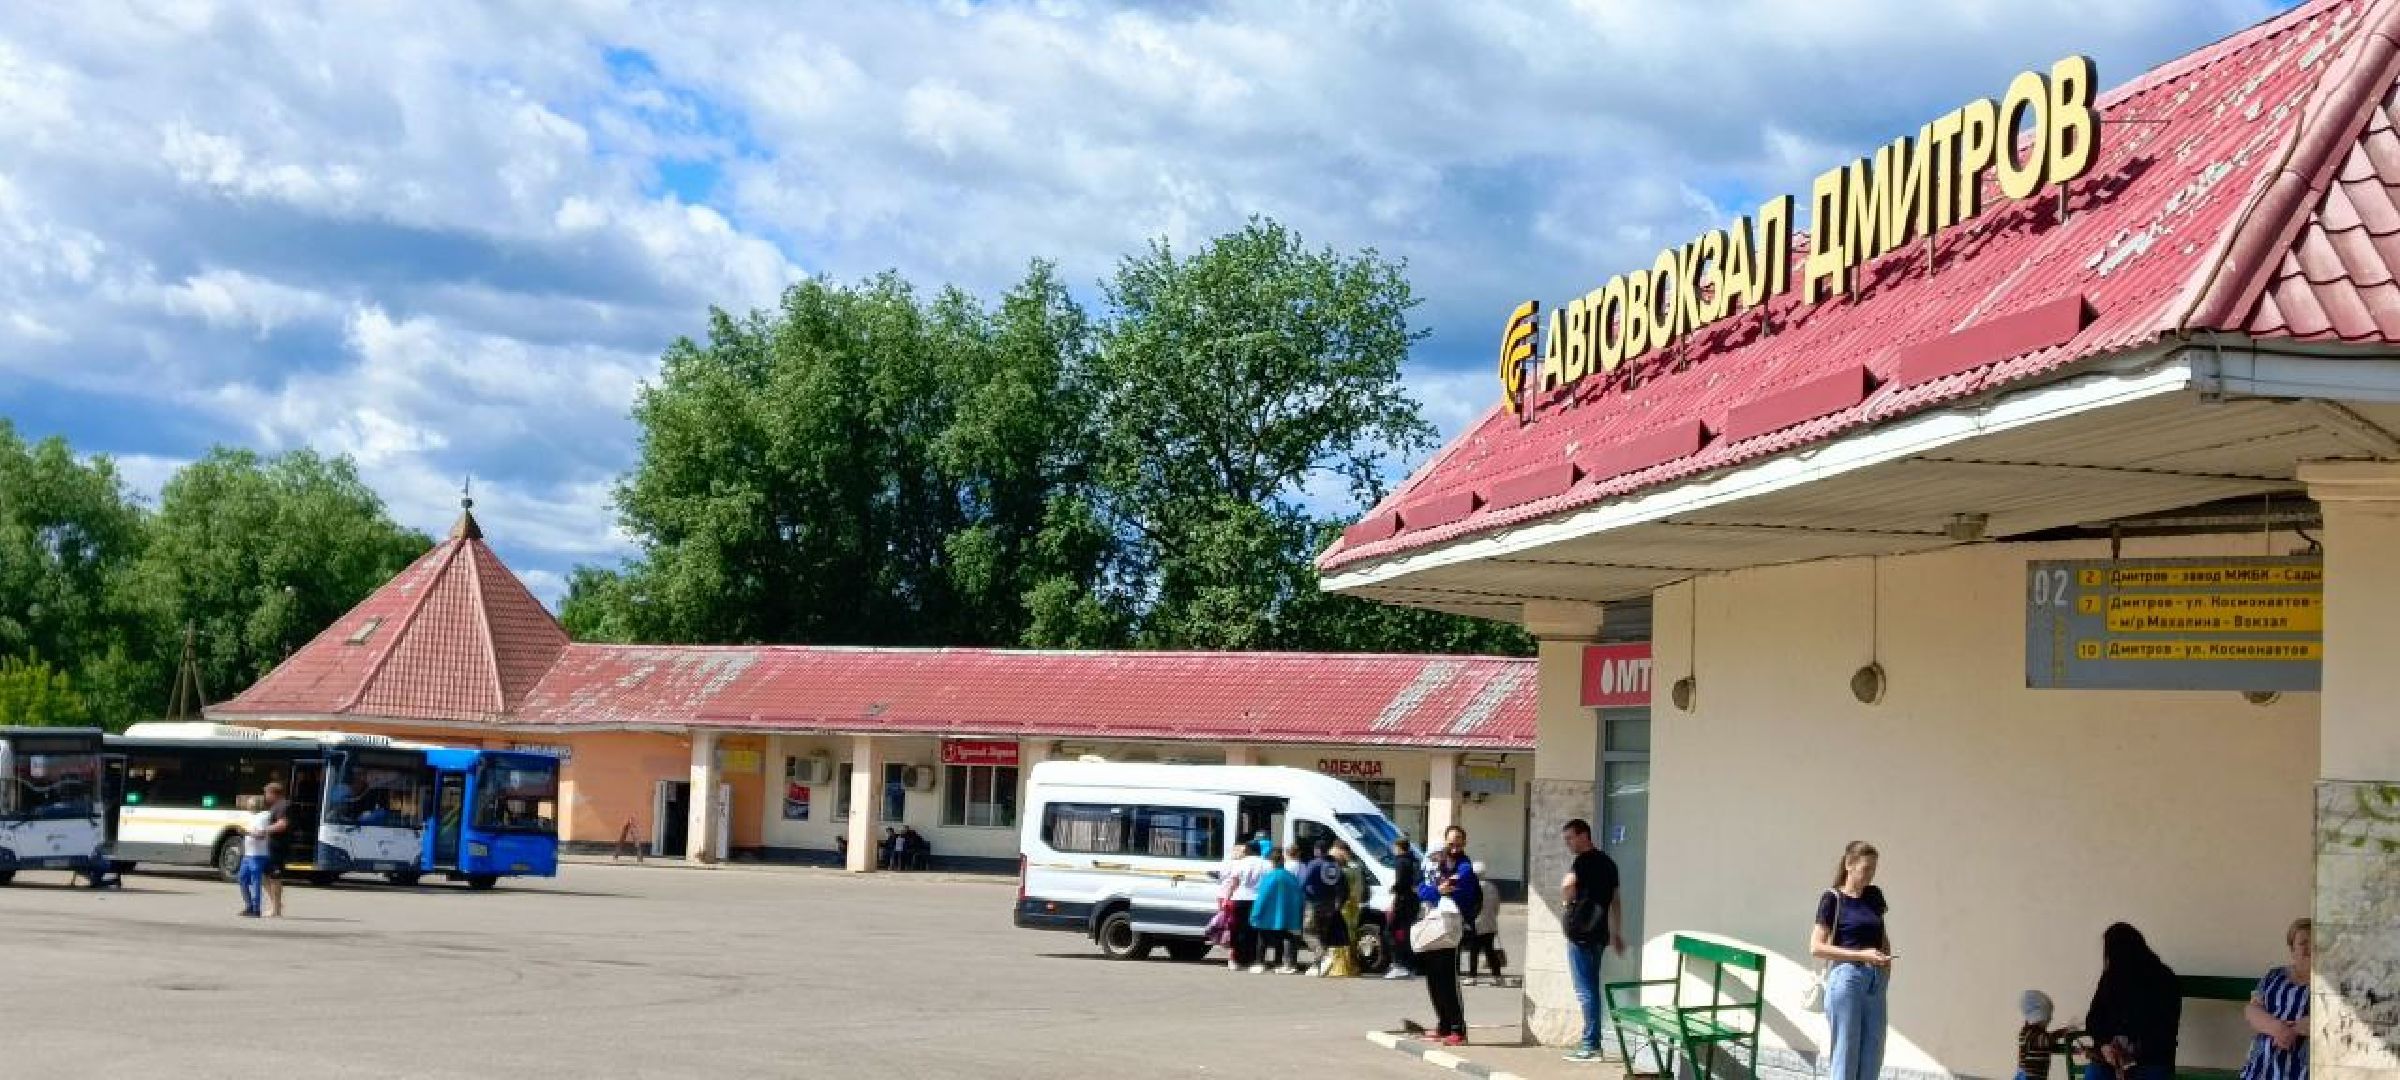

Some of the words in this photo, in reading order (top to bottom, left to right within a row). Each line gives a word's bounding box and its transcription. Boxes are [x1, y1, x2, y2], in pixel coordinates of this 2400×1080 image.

[1540, 194, 1794, 392] АВТОВОКЗАЛ
[1803, 55, 2100, 305] ДМИТРОВ
[2085, 570, 2096, 584] 2
[2111, 570, 2168, 584] Дмитров
[2034, 568, 2069, 606] 02
[2085, 599, 2093, 610] 7
[2111, 597, 2173, 611] Дмитров
[2211, 596, 2310, 608] Космонавтов
[2234, 615, 2288, 627] Вокзал
[2081, 644, 2097, 657] 10
[2109, 642, 2172, 657] Дмитров
[2209, 645, 2309, 656] Космонавтов
[1318, 758, 1382, 777] ОДЕЖДА
